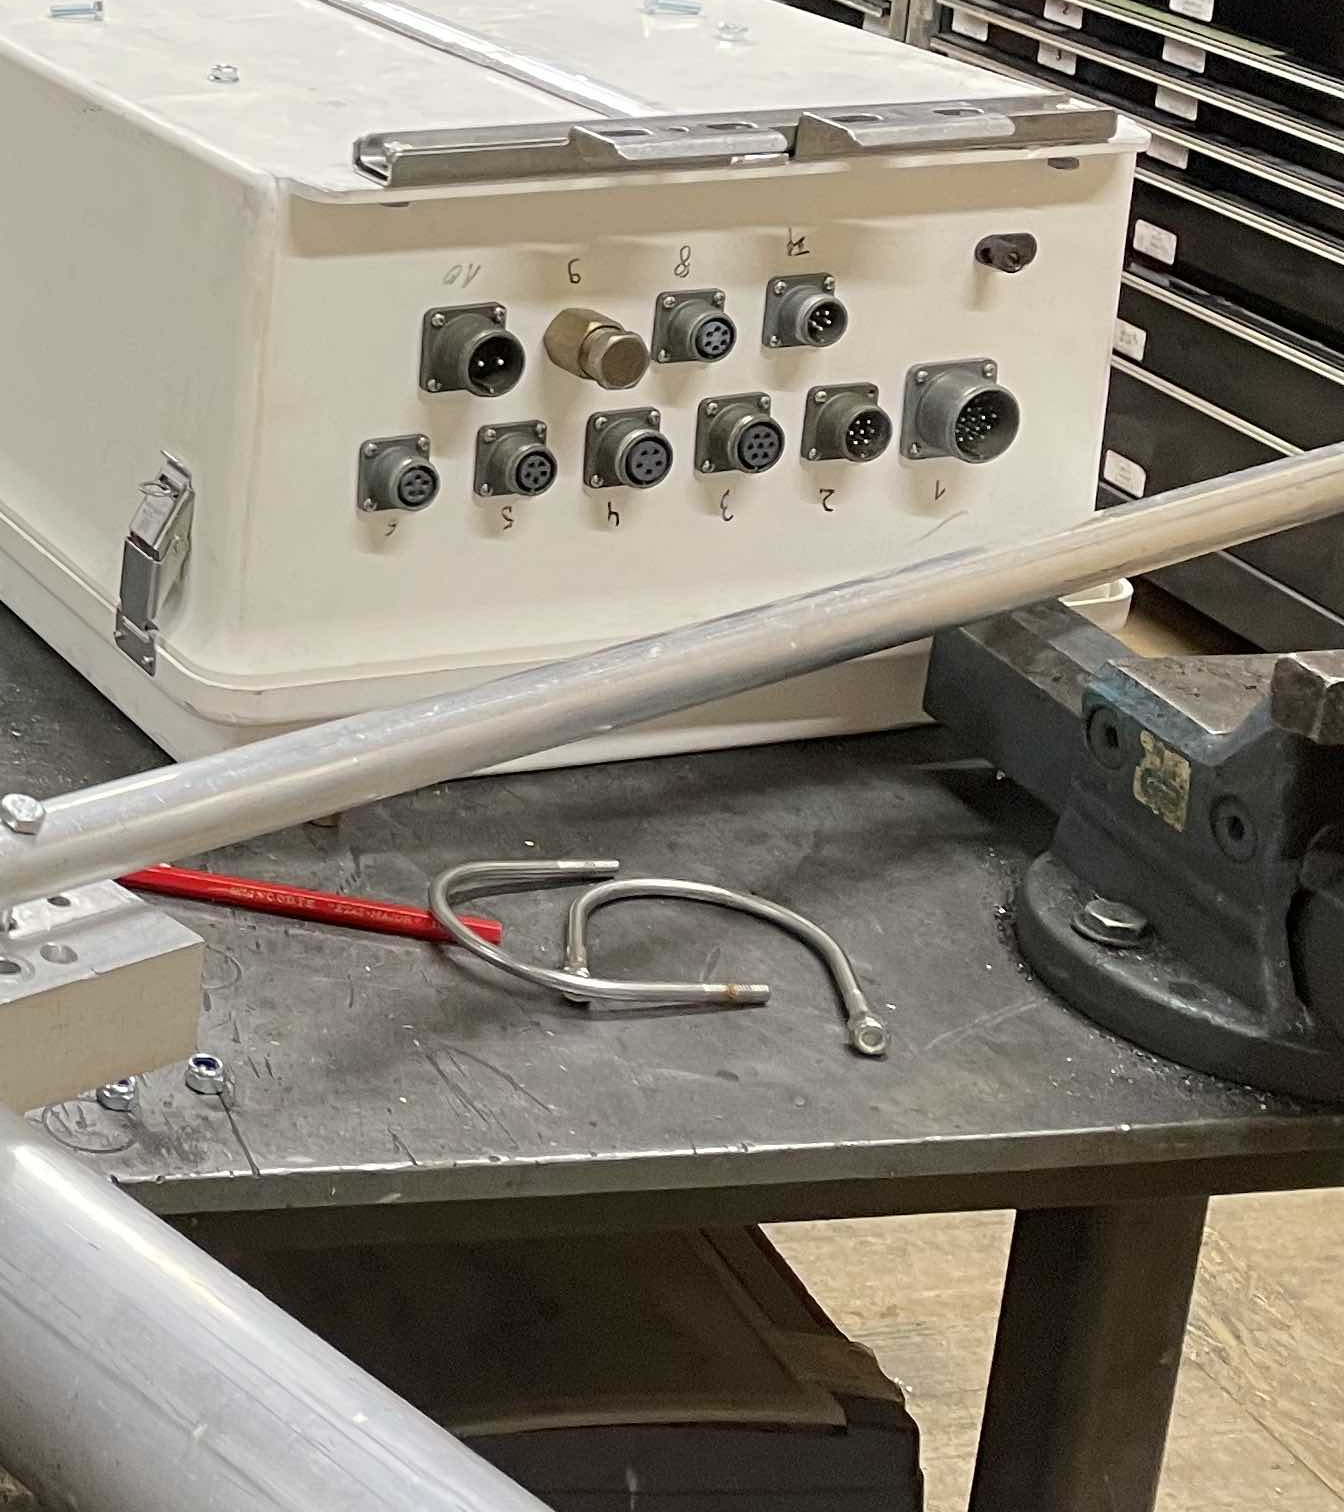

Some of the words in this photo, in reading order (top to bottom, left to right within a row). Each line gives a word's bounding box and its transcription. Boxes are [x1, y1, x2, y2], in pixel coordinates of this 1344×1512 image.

[674, 245, 691, 278] 8
[719, 489, 735, 522] 3
[819, 488, 836, 513] 2
[500, 505, 515, 530] 5
[607, 501, 620, 528] 4
